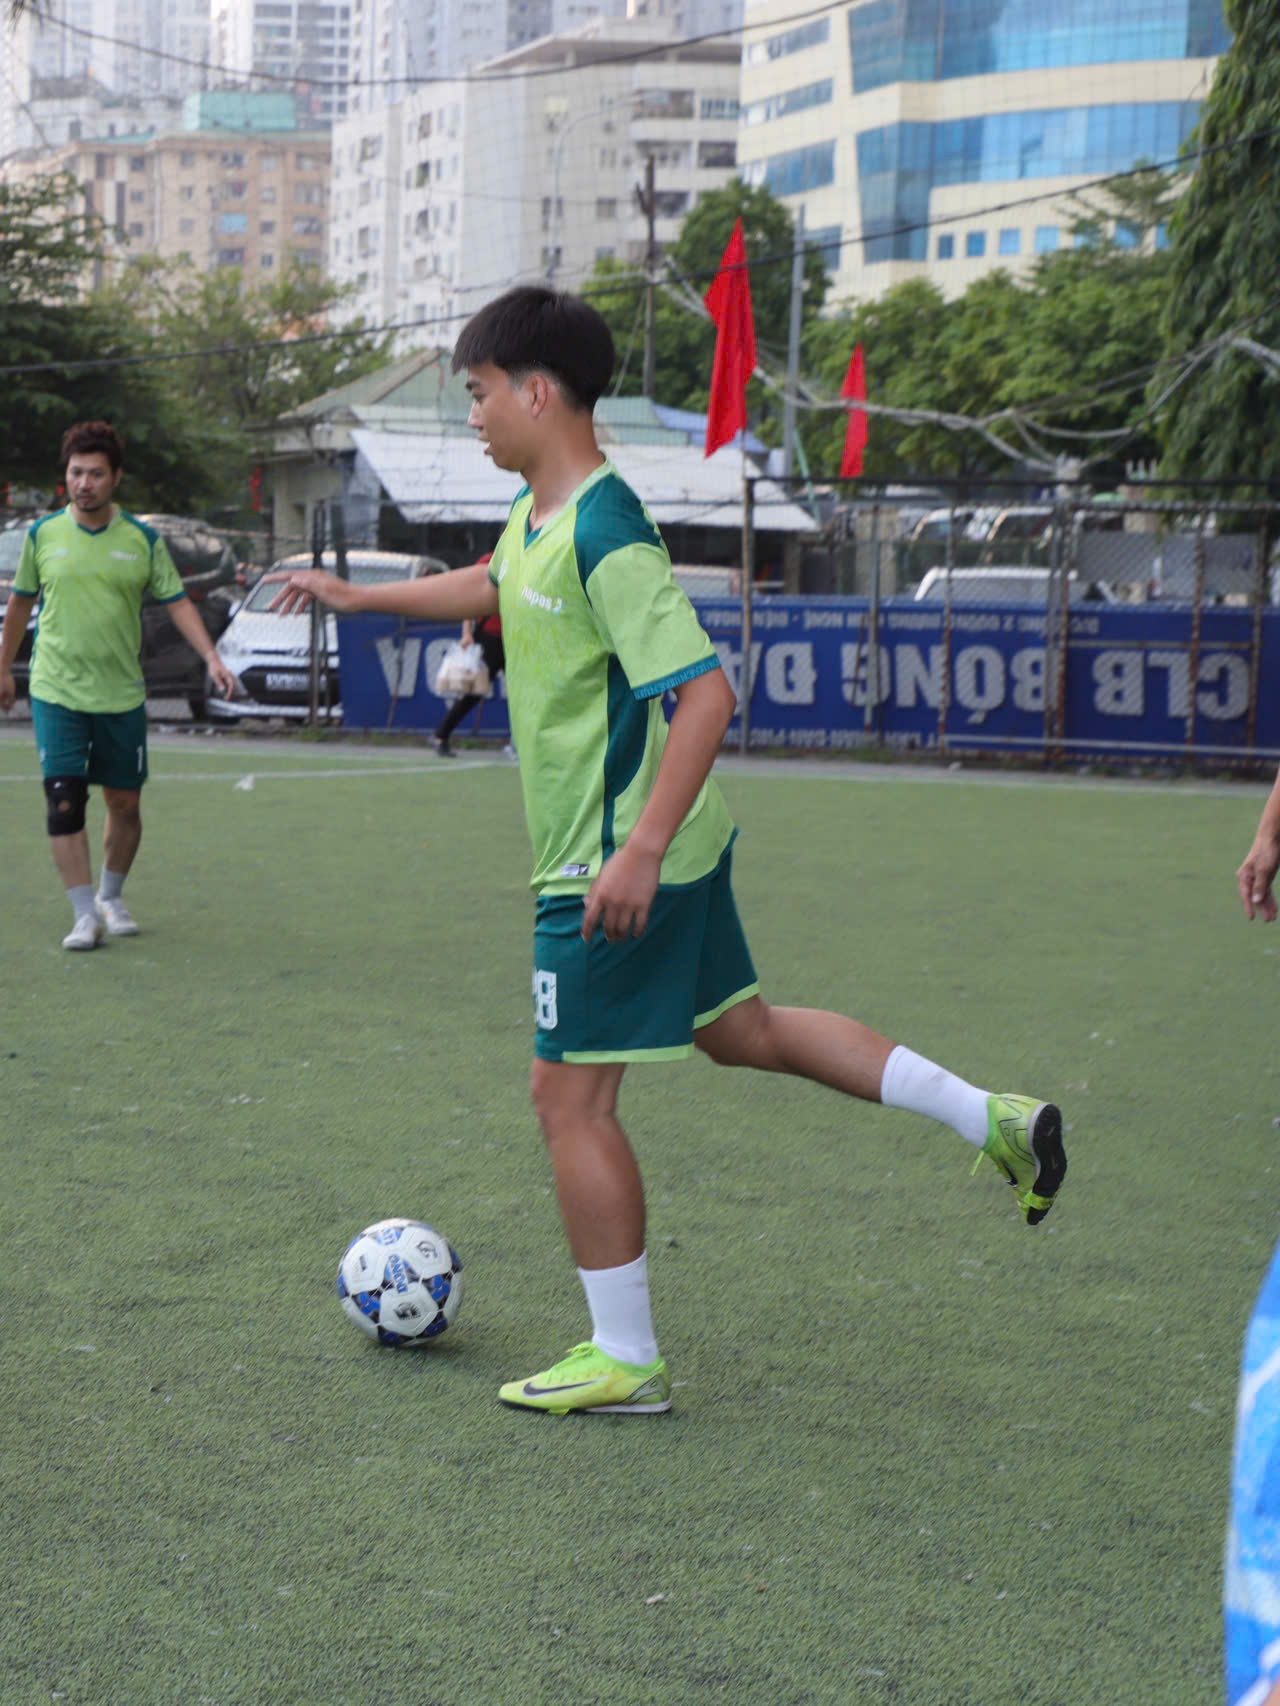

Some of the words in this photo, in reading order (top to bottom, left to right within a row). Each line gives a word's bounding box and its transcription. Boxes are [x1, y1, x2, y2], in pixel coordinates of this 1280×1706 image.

[841, 643, 1059, 723] BÓNG
[1092, 650, 1250, 721] CLB
[532, 967, 558, 1031] 8
